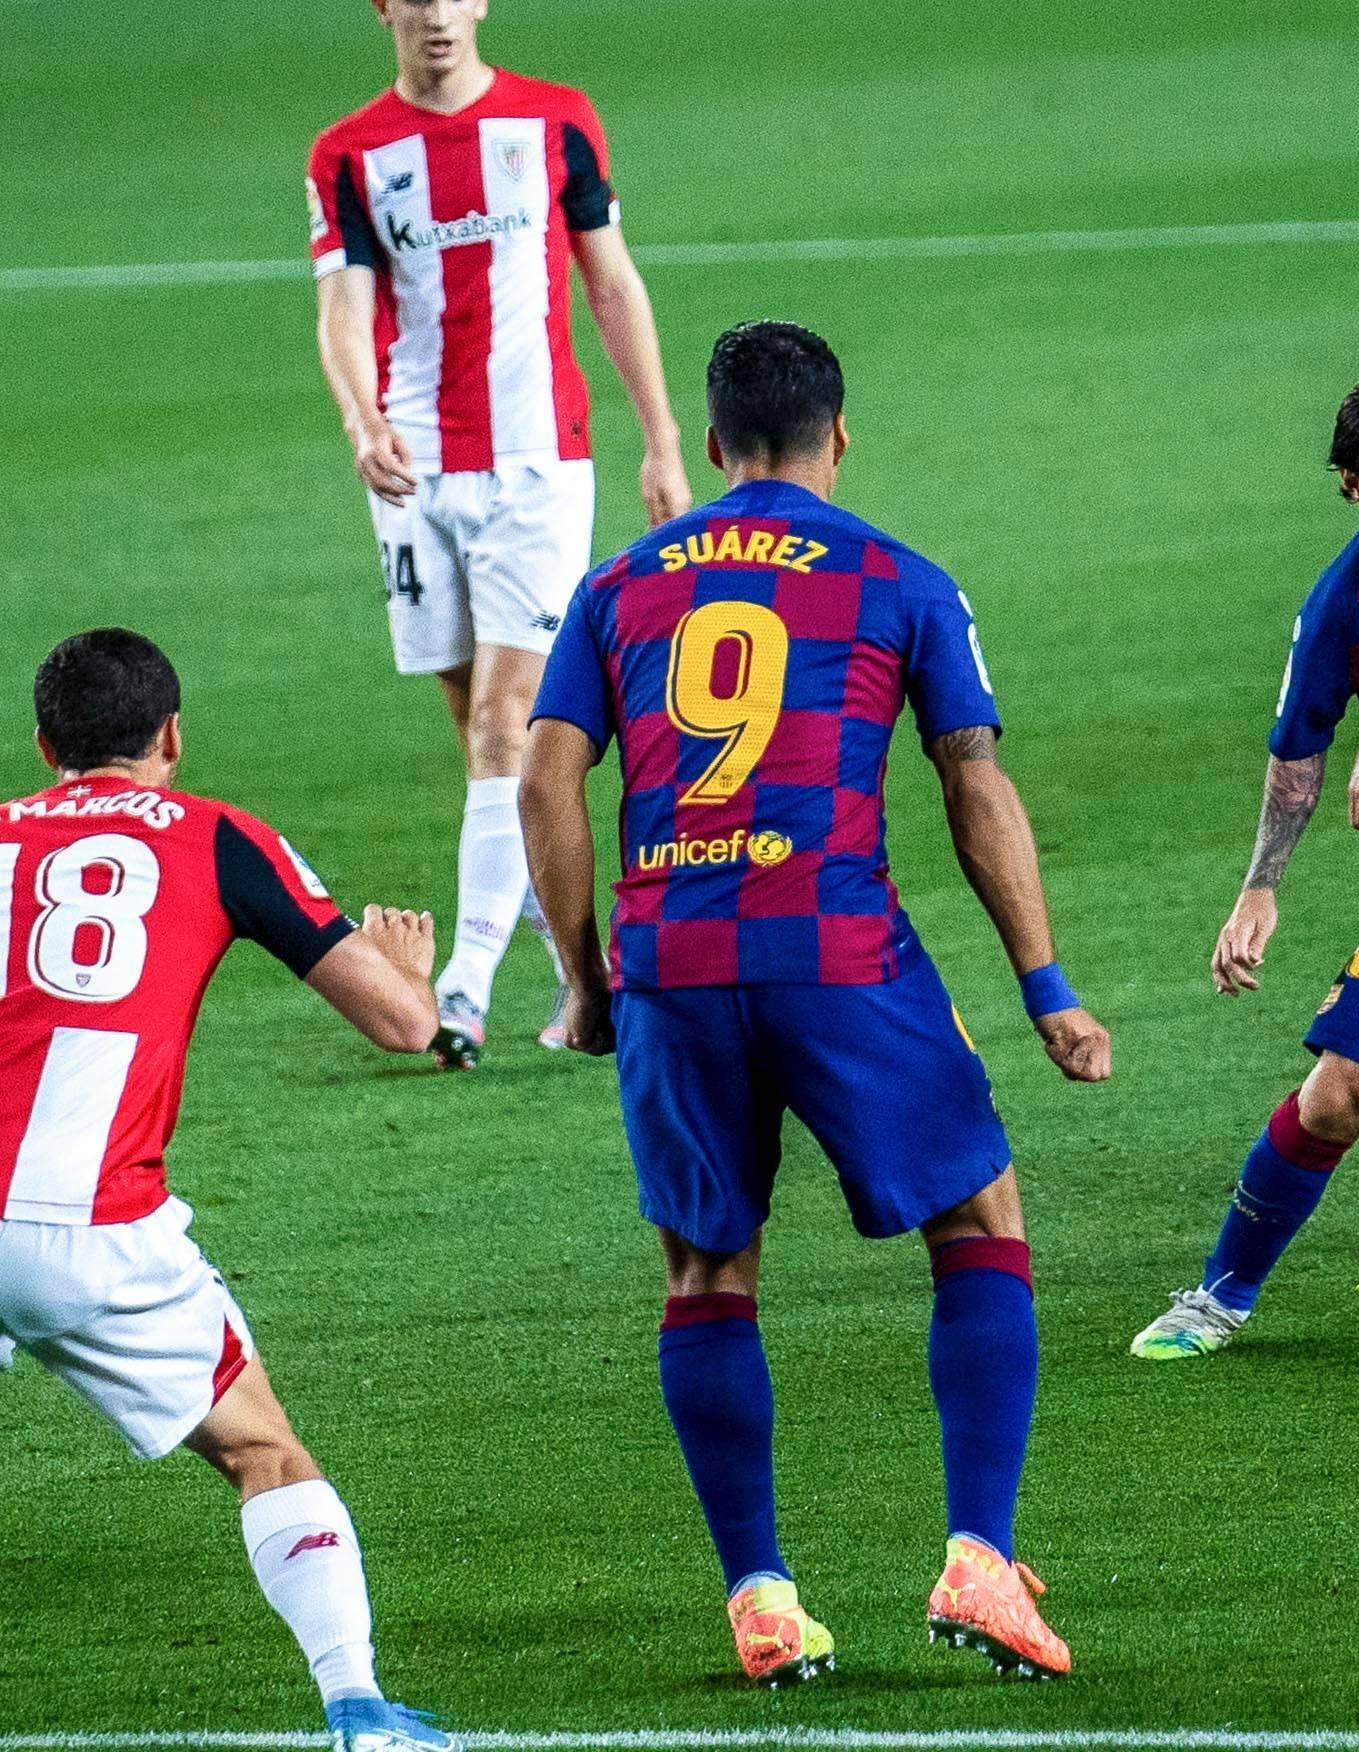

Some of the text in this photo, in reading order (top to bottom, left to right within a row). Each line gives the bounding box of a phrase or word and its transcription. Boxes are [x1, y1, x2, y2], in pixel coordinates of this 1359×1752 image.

[659, 525, 829, 574] SUÁREZ
[666, 600, 789, 805] 9
[9, 791, 186, 829] MARCOS
[638, 829, 746, 870] unicef
